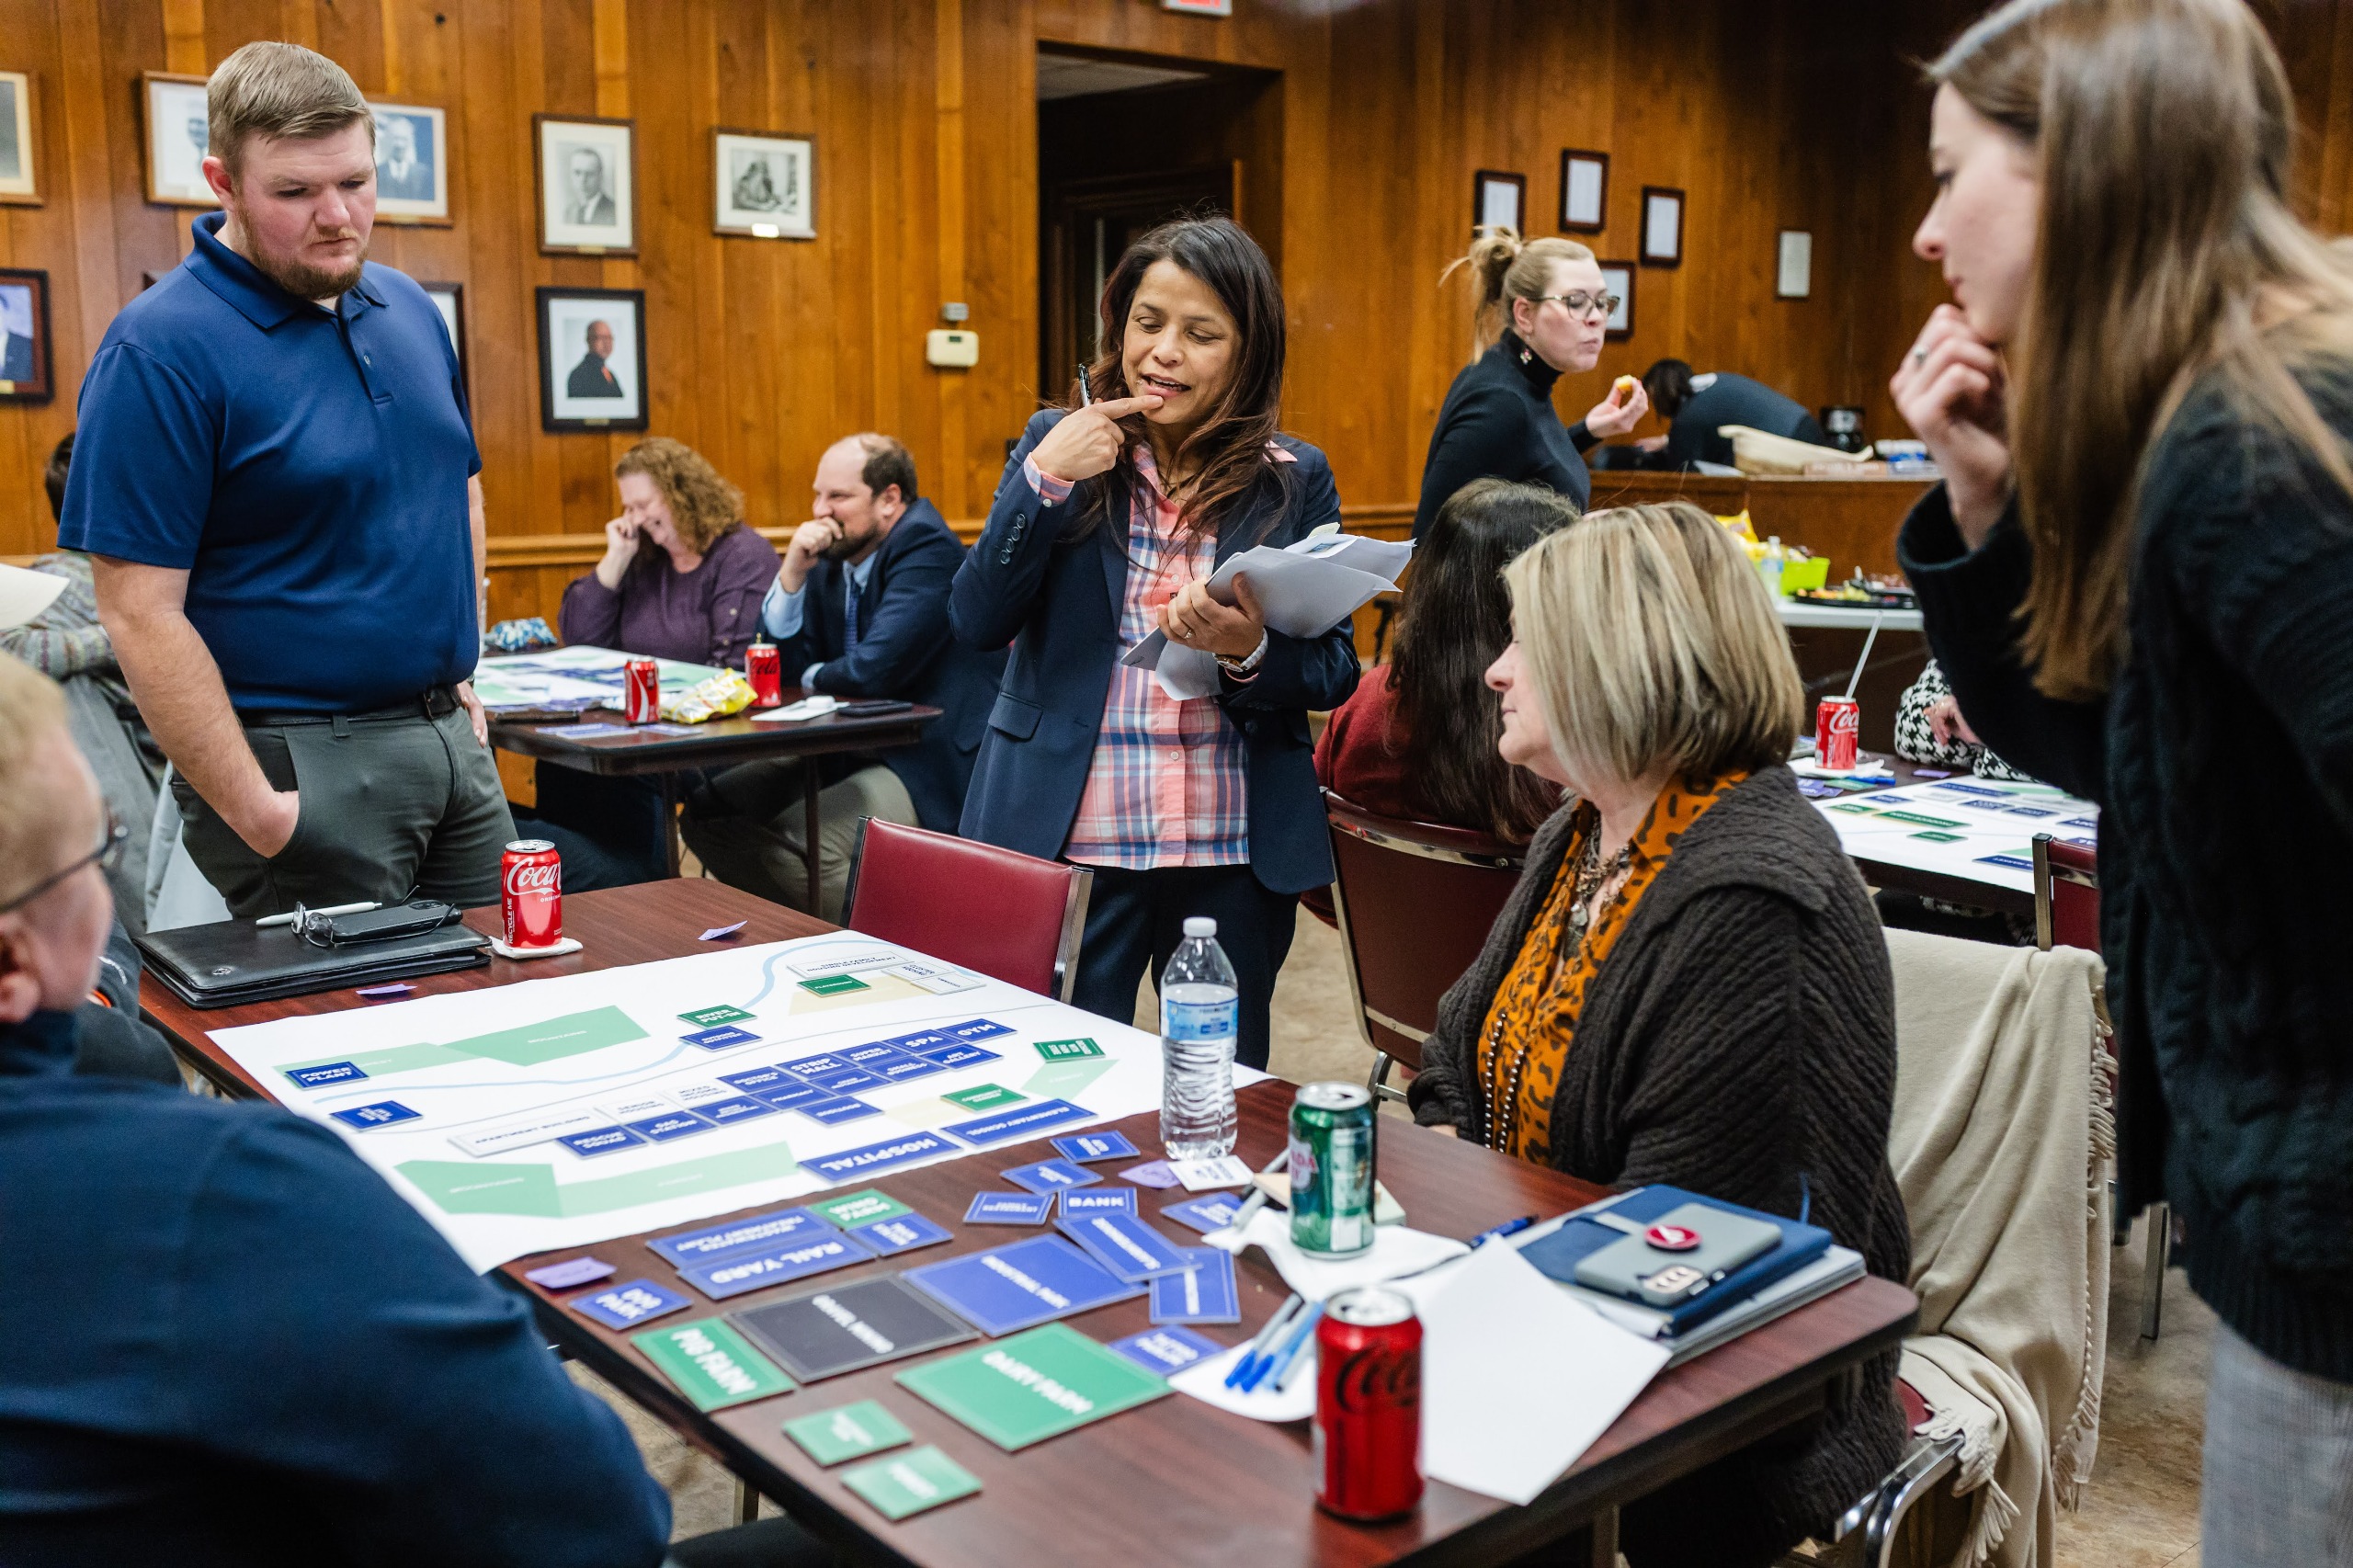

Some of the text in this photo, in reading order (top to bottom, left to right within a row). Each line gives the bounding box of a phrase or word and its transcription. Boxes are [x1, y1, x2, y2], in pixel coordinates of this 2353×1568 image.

[507, 897, 513, 910] ME
[845, 956, 896, 968] DEVELOPMENT
[695, 1009, 733, 1019] RIVER
[699, 1011, 742, 1023] PUT-IN
[957, 1023, 997, 1036] GYM
[904, 1036, 944, 1048] SPA
[852, 1049, 892, 1062] MARKET
[790, 1058, 832, 1072] STRIP
[800, 1062, 844, 1074] MALL
[300, 1067, 352, 1079] POWER
[306, 1071, 353, 1083] PLANT
[649, 1119, 699, 1135] STATION
[573, 1131, 625, 1146] RESCUE
[581, 1136, 627, 1149] SQUAD
[819, 1137, 939, 1172] HOSPITAL
[1068, 1196, 1125, 1208] BANK
[709, 1241, 846, 1285] RAIL YARD
[669, 1327, 758, 1396] PIG FARM
[980, 1349, 1095, 1416] DAIRY FARM
